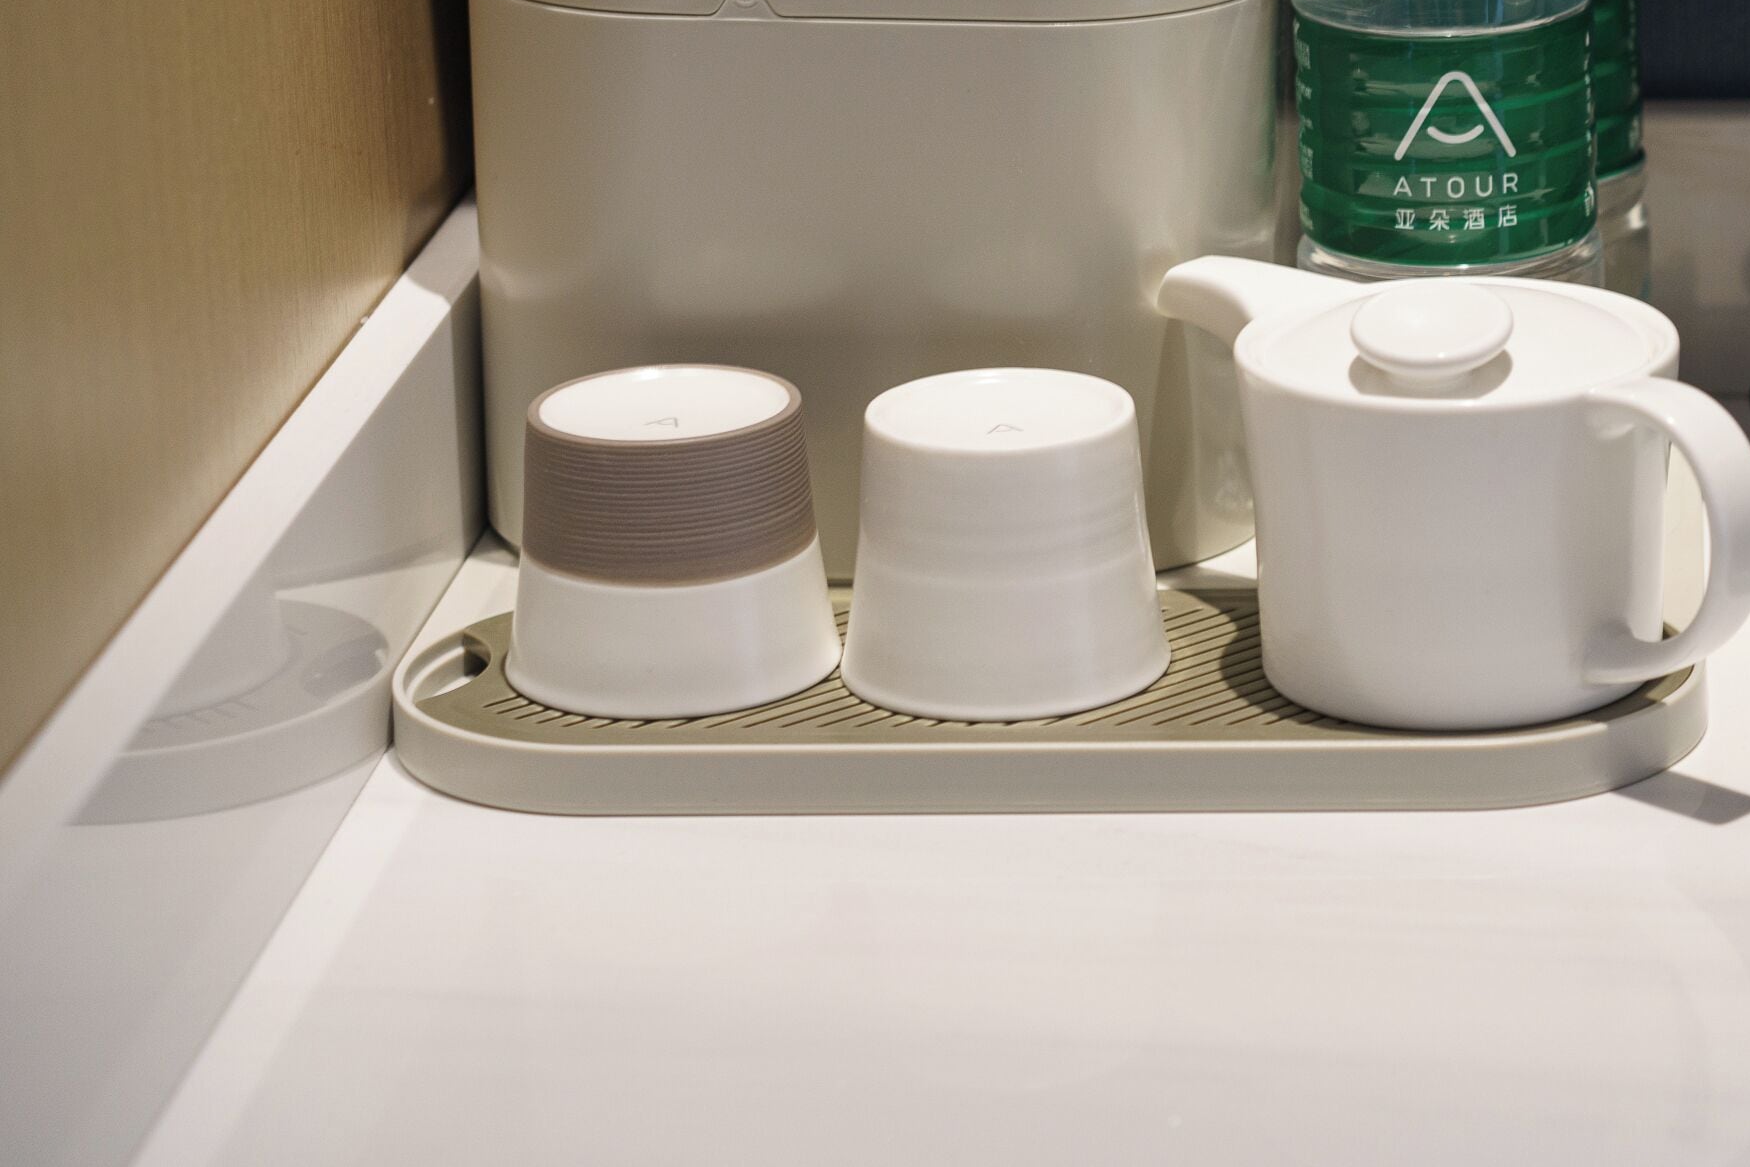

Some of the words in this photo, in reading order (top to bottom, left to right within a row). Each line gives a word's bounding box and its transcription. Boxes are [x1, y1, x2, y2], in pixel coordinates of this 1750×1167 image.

[1393, 173, 1519, 199] ATOUR
[1394, 205, 1518, 231] 亚朵酒店
